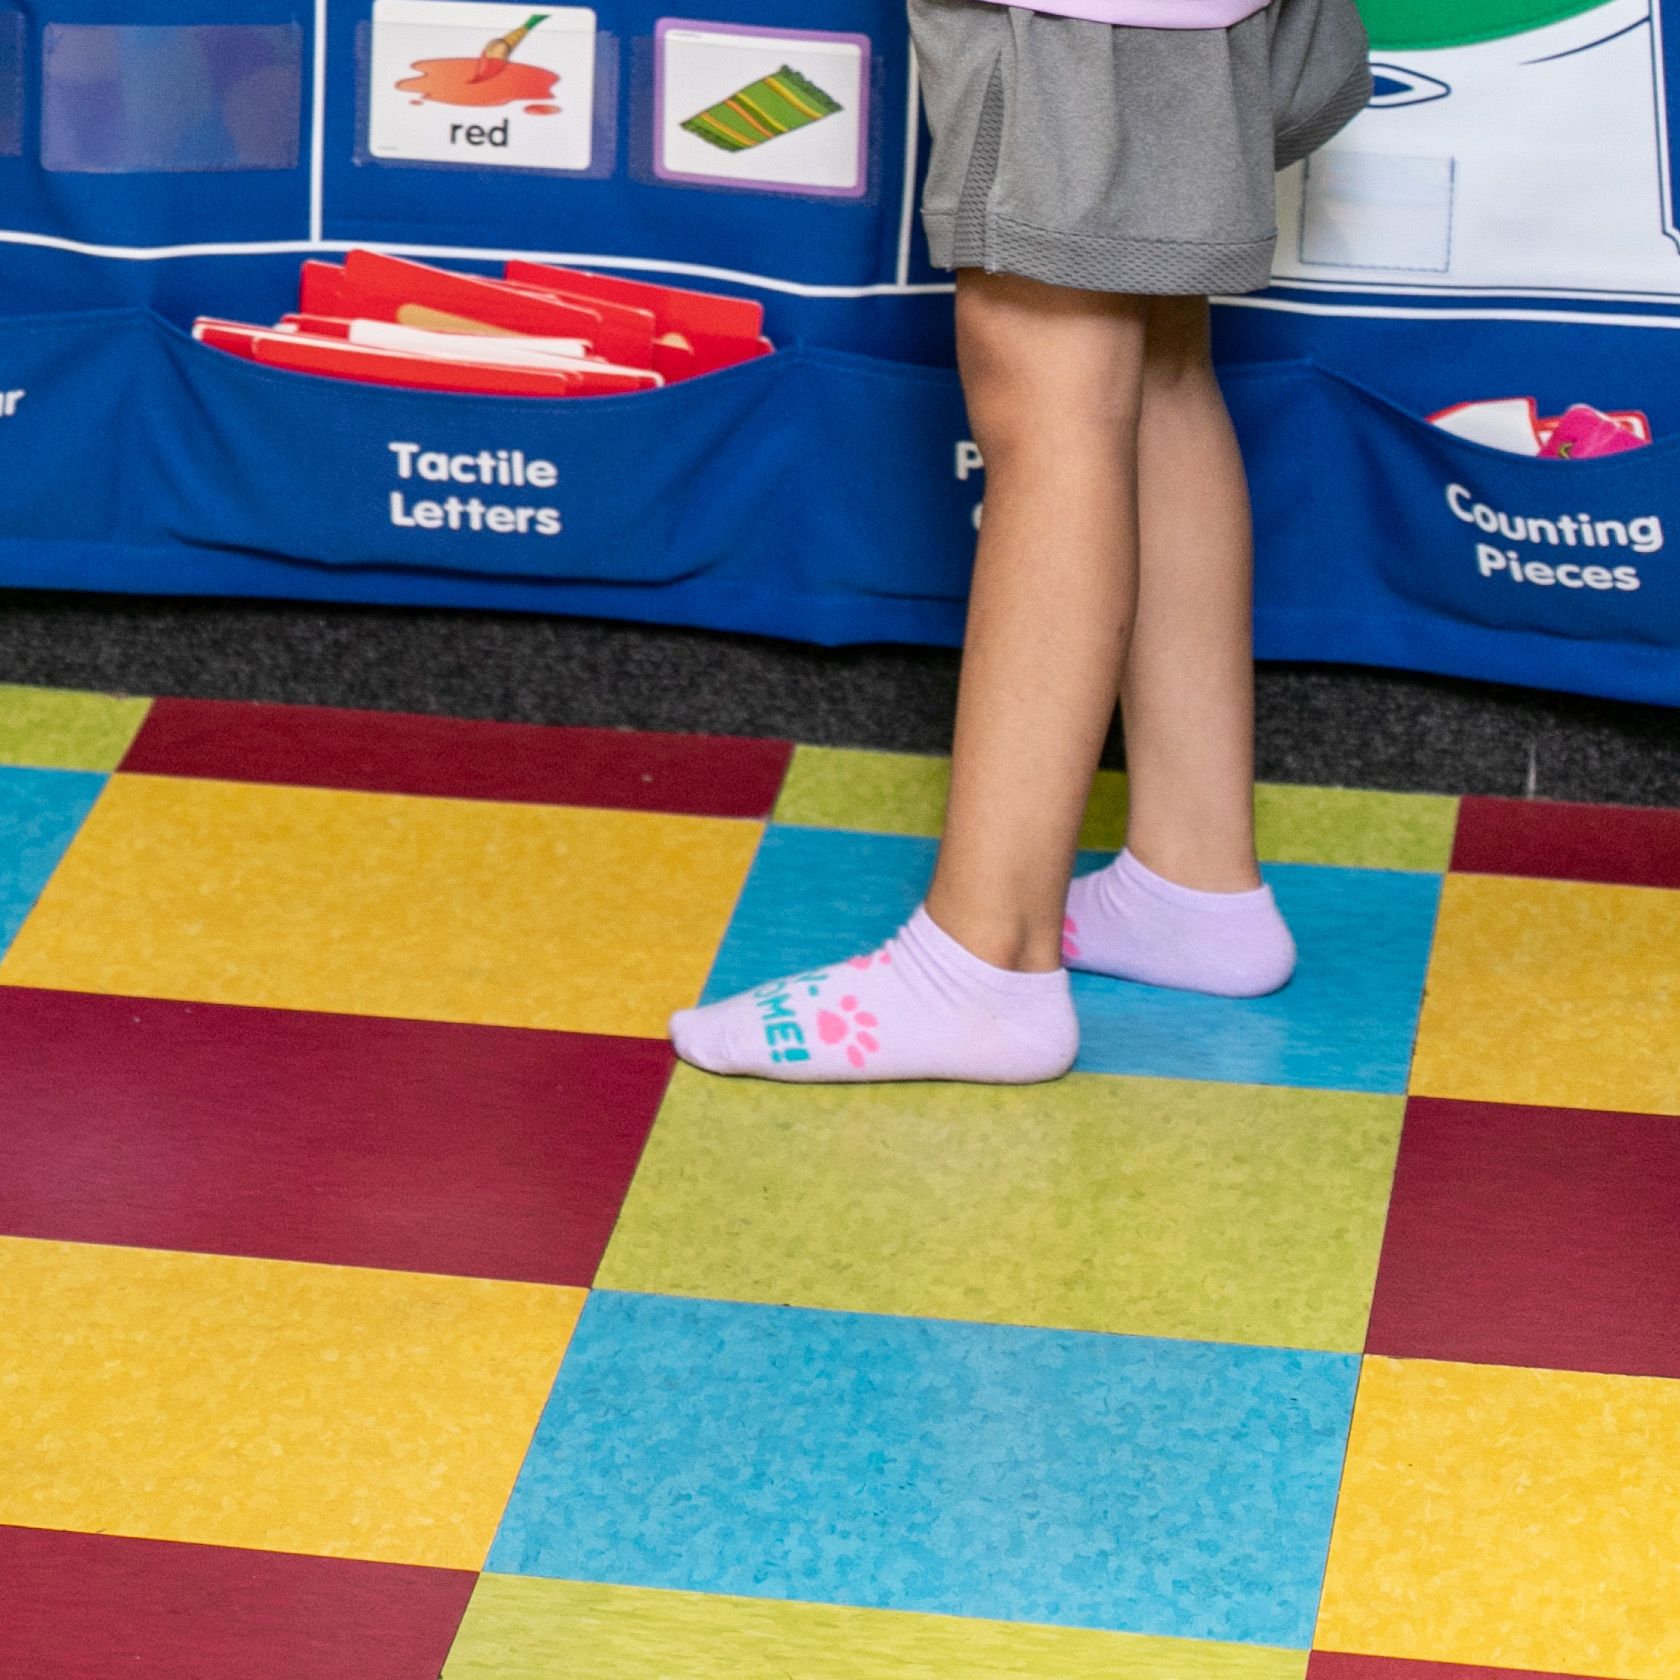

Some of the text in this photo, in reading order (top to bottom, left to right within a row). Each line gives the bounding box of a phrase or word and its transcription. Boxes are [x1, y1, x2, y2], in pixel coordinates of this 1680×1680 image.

[451, 119, 508, 146] red
[389, 443, 557, 487] Tactile
[391, 492, 560, 534] Letters
[1446, 483, 1664, 555] Counting
[1478, 540, 1643, 590] Pieces
